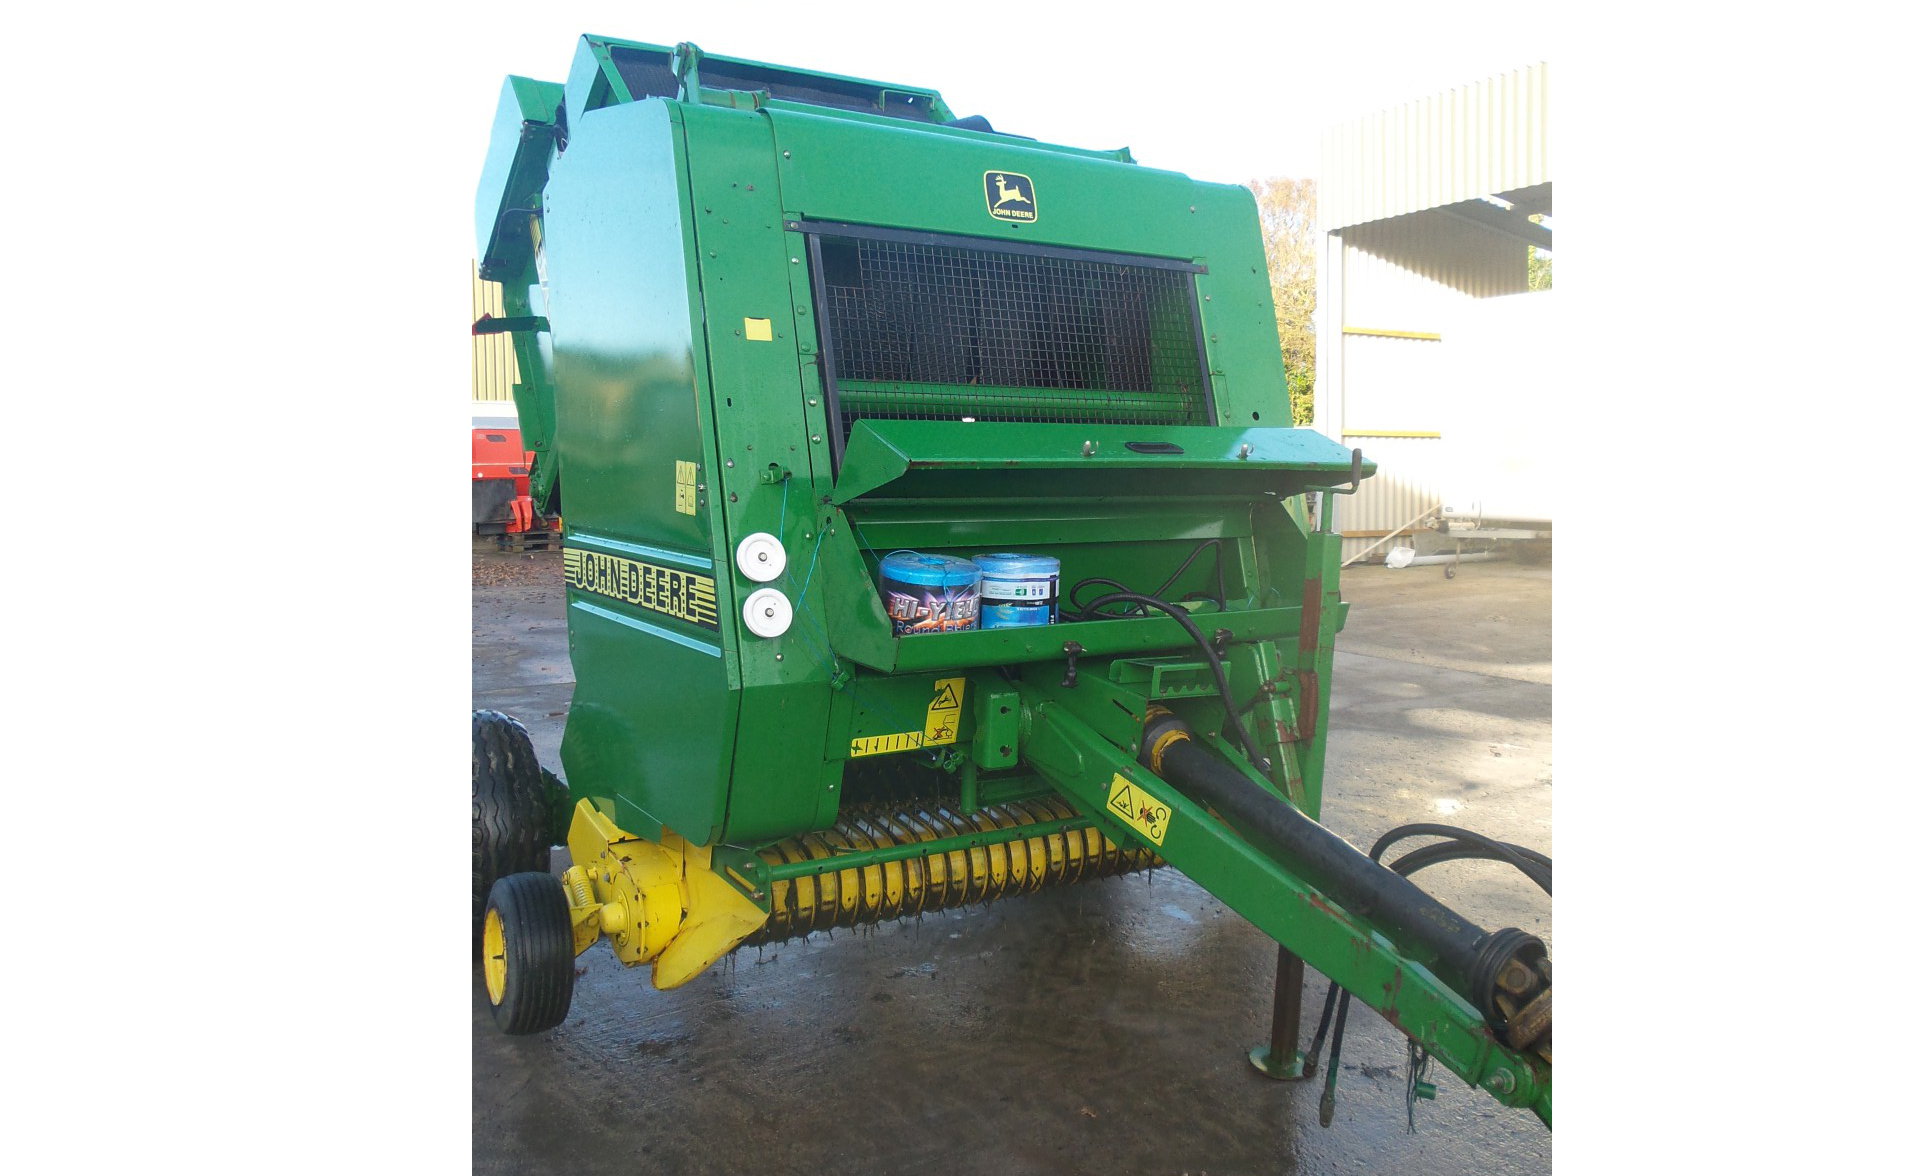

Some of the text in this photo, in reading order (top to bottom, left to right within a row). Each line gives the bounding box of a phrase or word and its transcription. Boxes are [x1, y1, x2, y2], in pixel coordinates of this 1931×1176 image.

[992, 208, 1034, 218] JOHN DEERE
[575, 551, 698, 621] JOHN DEERE
